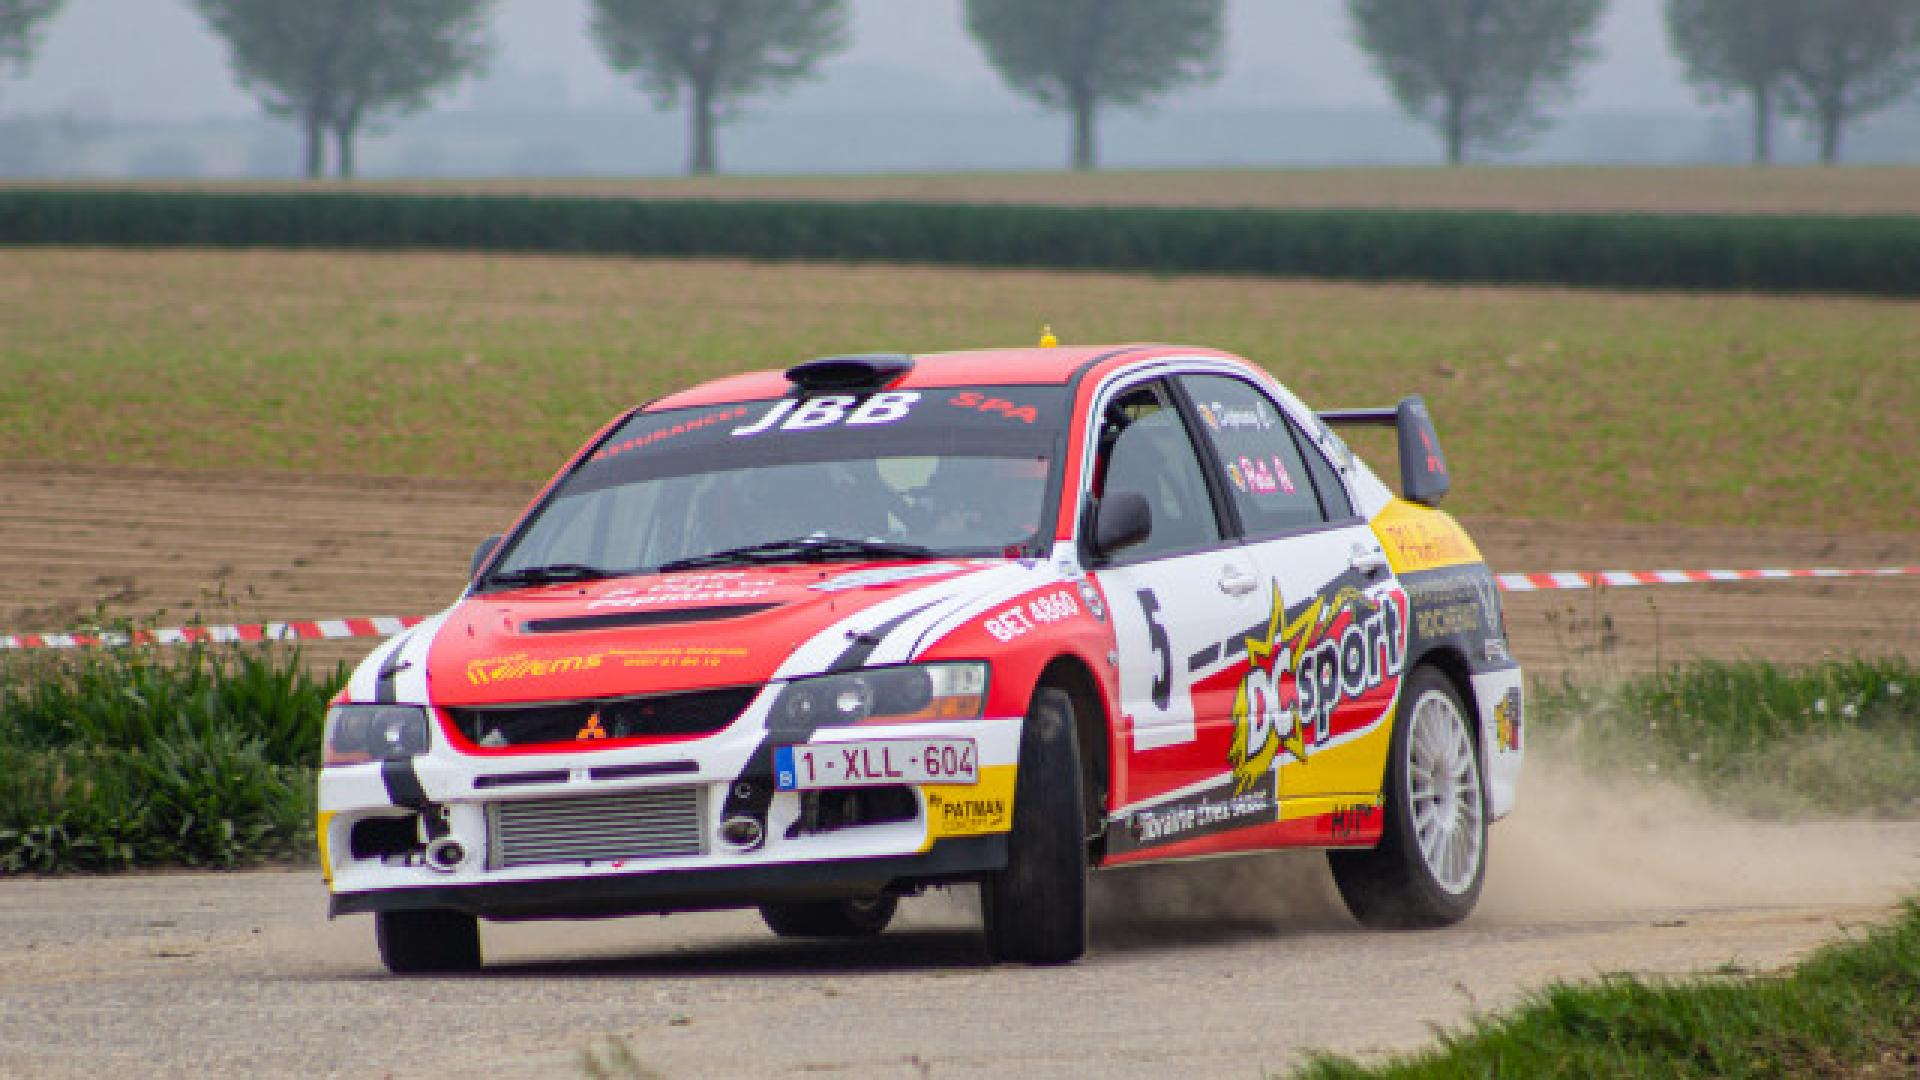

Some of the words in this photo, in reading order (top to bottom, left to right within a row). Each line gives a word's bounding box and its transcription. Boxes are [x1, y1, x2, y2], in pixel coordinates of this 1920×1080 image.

[732, 391, 922, 436] JBB
[950, 392, 1038, 424] SPA
[983, 606, 1035, 642] BET
[1136, 588, 1173, 711] 5
[944, 800, 1004, 820] PATMAN
